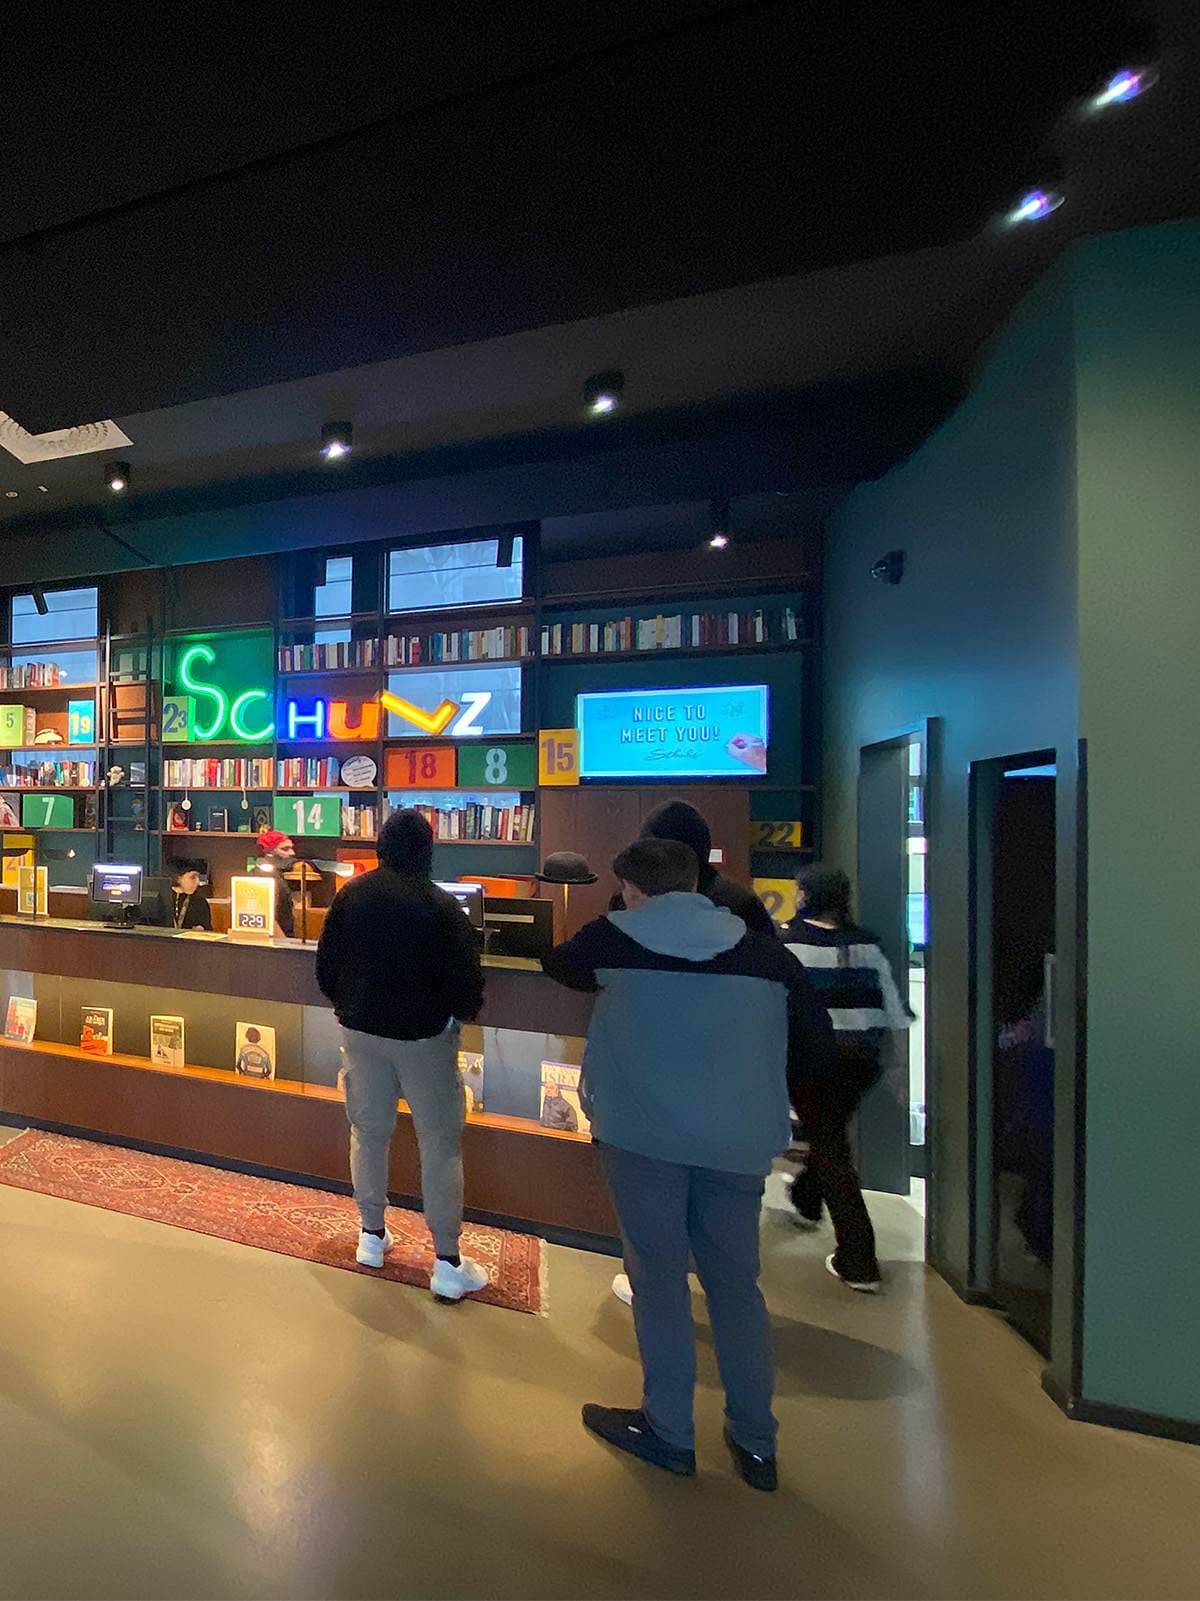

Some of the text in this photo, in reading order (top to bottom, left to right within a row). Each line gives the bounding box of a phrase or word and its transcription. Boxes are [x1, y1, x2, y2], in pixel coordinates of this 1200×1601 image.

[5, 712, 15, 728] 5
[70, 710, 91, 737] 19
[162, 703, 187, 733] 23
[632, 704, 706, 722] NICE TO
[620, 726, 720, 743] MEET YOU!
[404, 750, 437, 785] 18
[485, 747, 508, 786] 8
[541, 739, 575, 775] 15
[41, 796, 56, 826] 7
[292, 799, 323, 834] 14
[759, 822, 794, 848] 22
